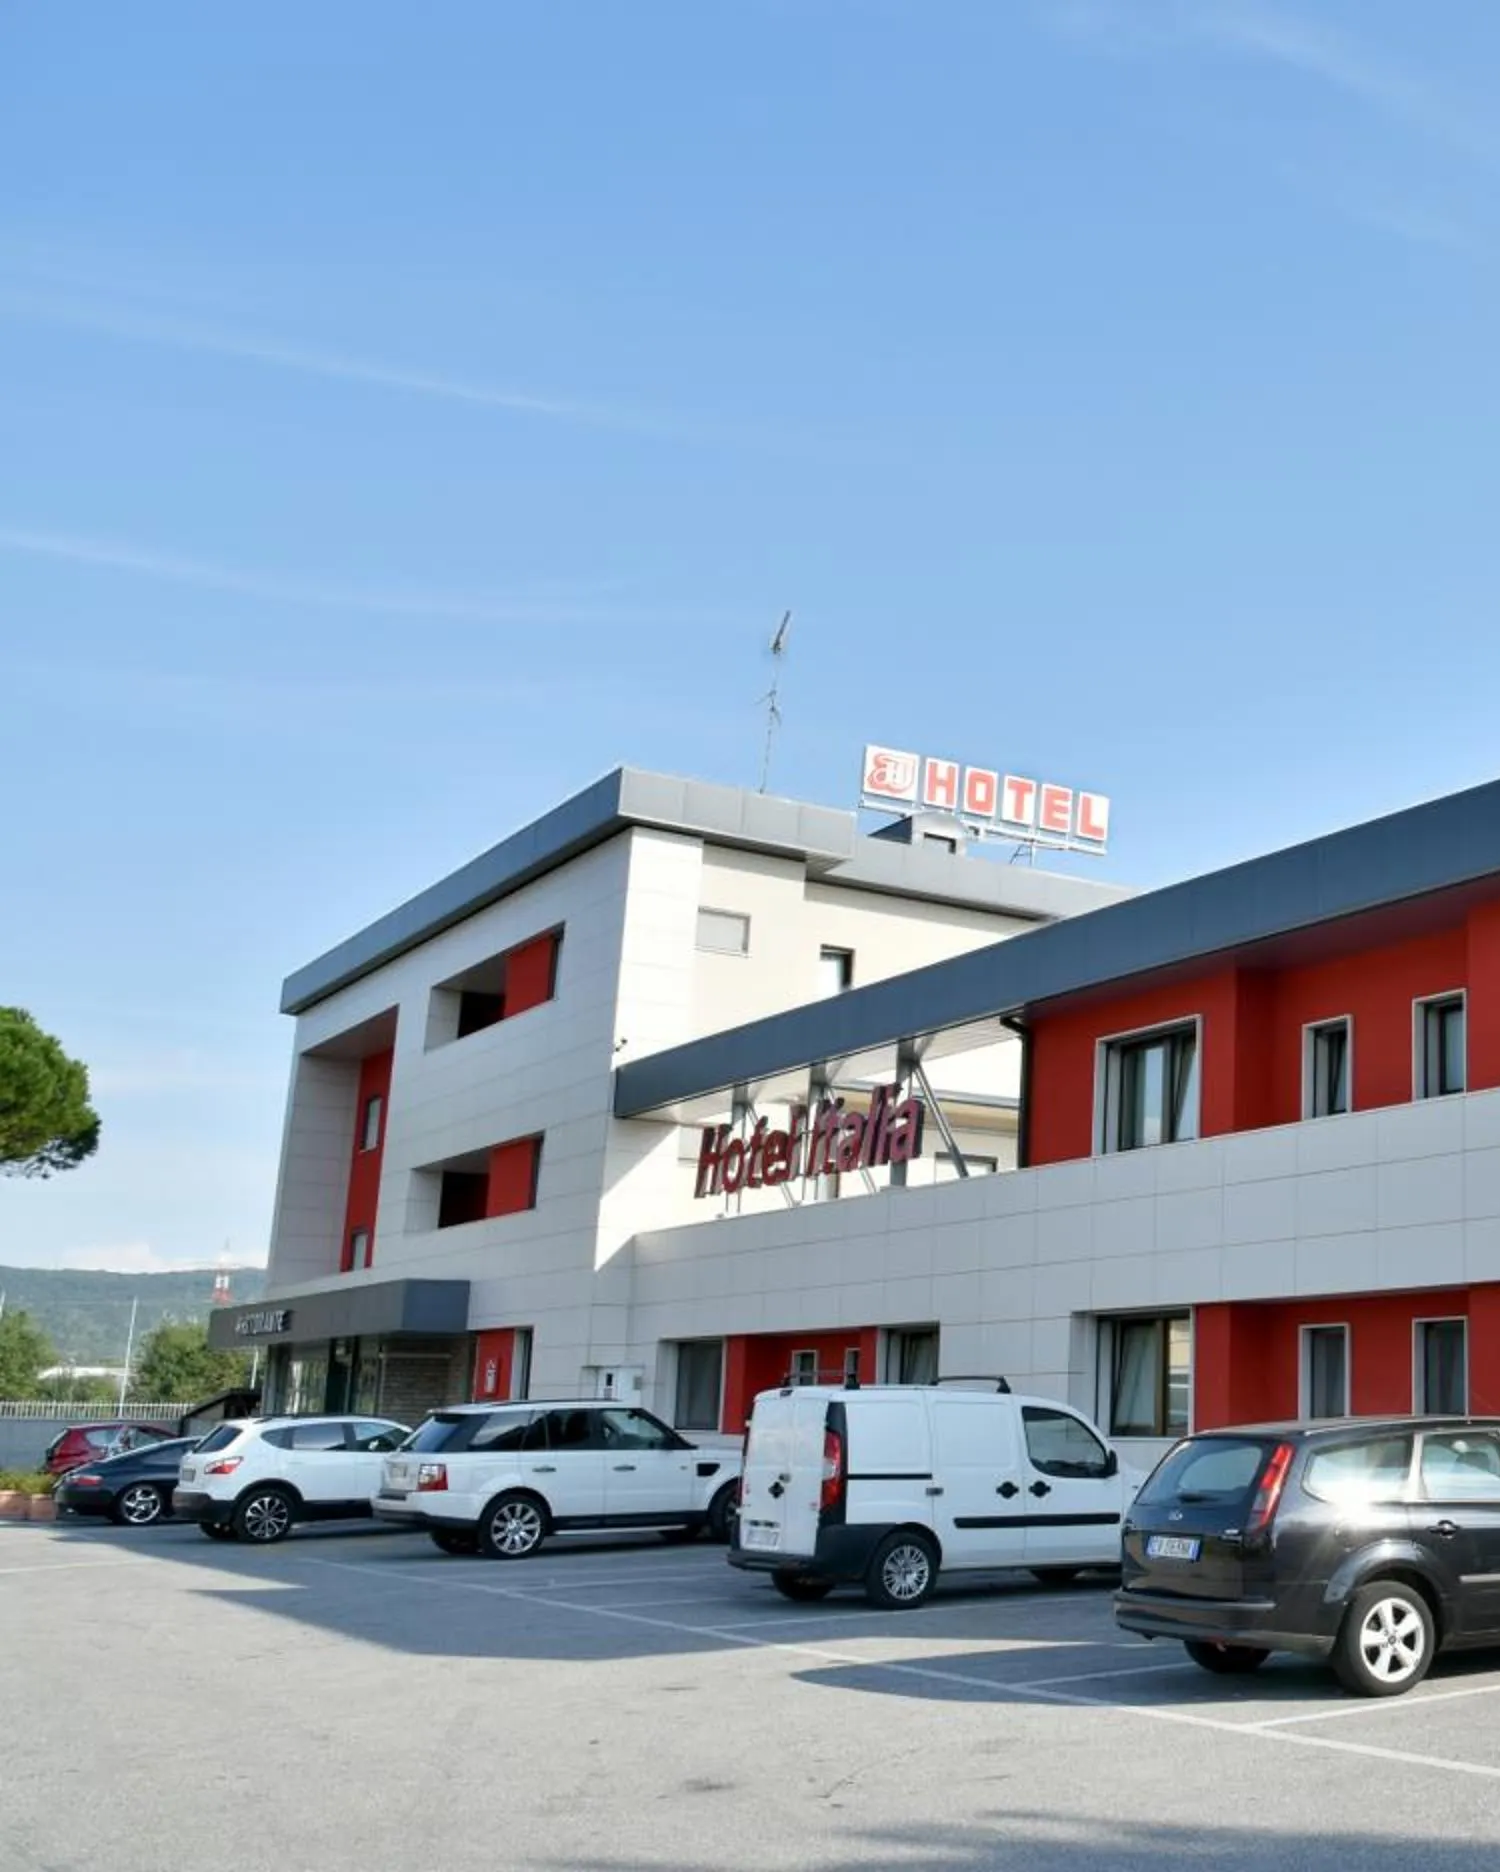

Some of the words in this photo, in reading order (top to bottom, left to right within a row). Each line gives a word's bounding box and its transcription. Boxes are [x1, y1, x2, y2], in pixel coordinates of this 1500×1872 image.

[925, 761, 1107, 839] HOTEL
[694, 1103, 807, 1199] Hotel
[806, 1082, 925, 1178] Italia
